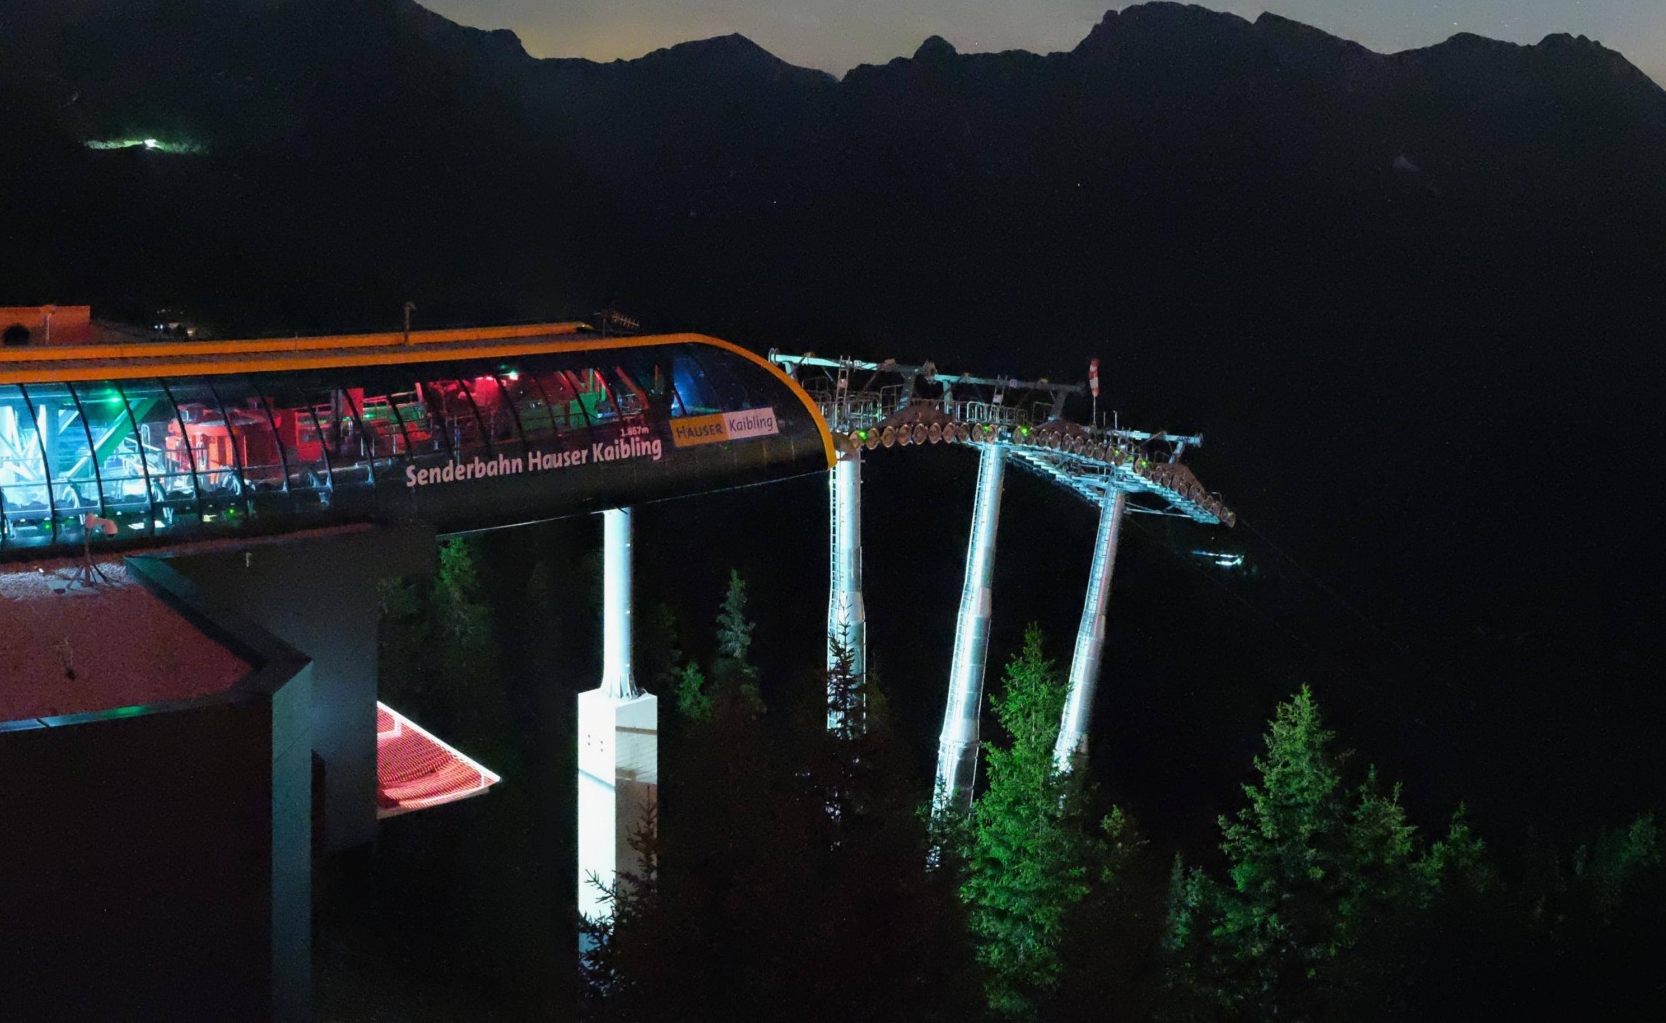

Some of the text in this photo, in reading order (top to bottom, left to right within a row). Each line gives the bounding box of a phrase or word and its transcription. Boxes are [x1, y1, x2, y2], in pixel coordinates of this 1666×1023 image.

[676, 414, 773, 440] HAUSER Kaibling
[406, 437, 663, 488] Senderbahn Hauser Kaibling
